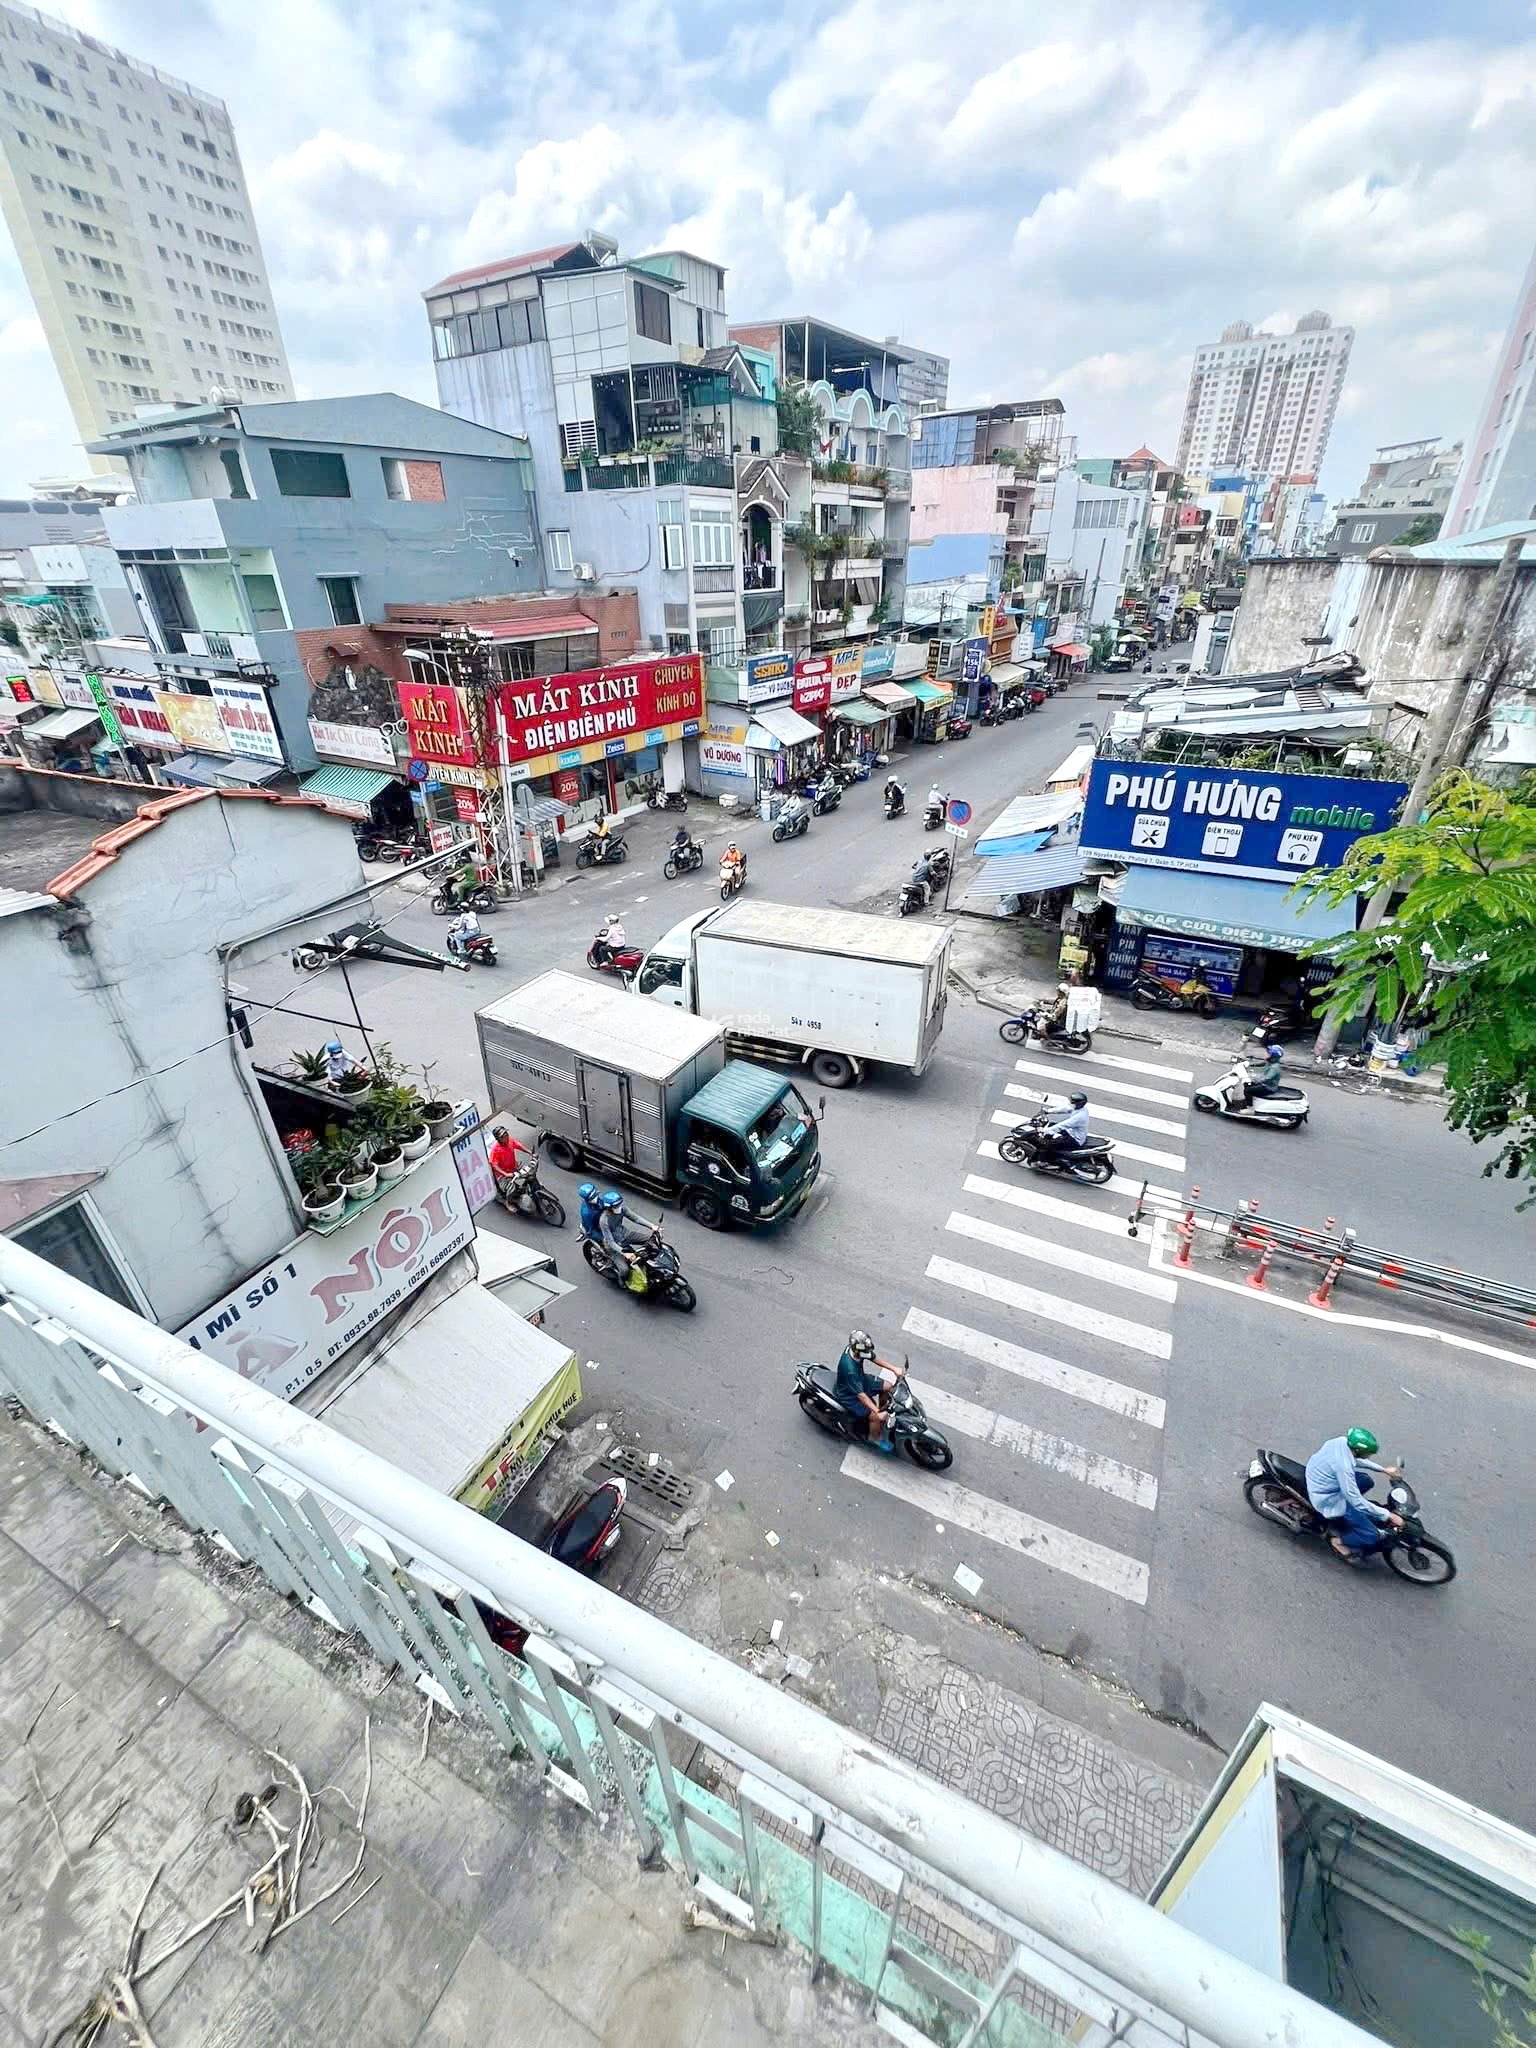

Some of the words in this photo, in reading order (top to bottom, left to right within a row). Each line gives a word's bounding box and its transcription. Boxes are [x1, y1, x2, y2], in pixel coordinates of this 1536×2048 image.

[512, 677, 571, 720] MẮT
[578, 673, 640, 707] KÍNH
[656, 691, 680, 714] KÍNH
[414, 724, 460, 757] KÍNH
[524, 720, 566, 751] ĐIỆN
[568, 711, 605, 741] BIÊN
[606, 700, 637, 732] PHỦ
[456, 798, 476, 812] 20%
[560, 780, 579, 793] 20%
[1105, 770, 1177, 811] PHÚ
[1182, 778, 1282, 822] HƯNG
[1290, 804, 1375, 831] mobile
[1118, 924, 1142, 936] THAY
[1119, 938, 1136, 950] PIN
[310, 1187, 455, 1325] NỘI
[205, 1302, 242, 1340] MÌ
[245, 1270, 279, 1309] SỐ
[283, 1262, 298, 1279] 1
[327, 1341, 344, 1358] ĐT:
[342, 1288, 402, 1343] 0933.88.7939
[407, 1264, 430, 1288] (028)
[429, 1233, 466, 1268] 66802397
